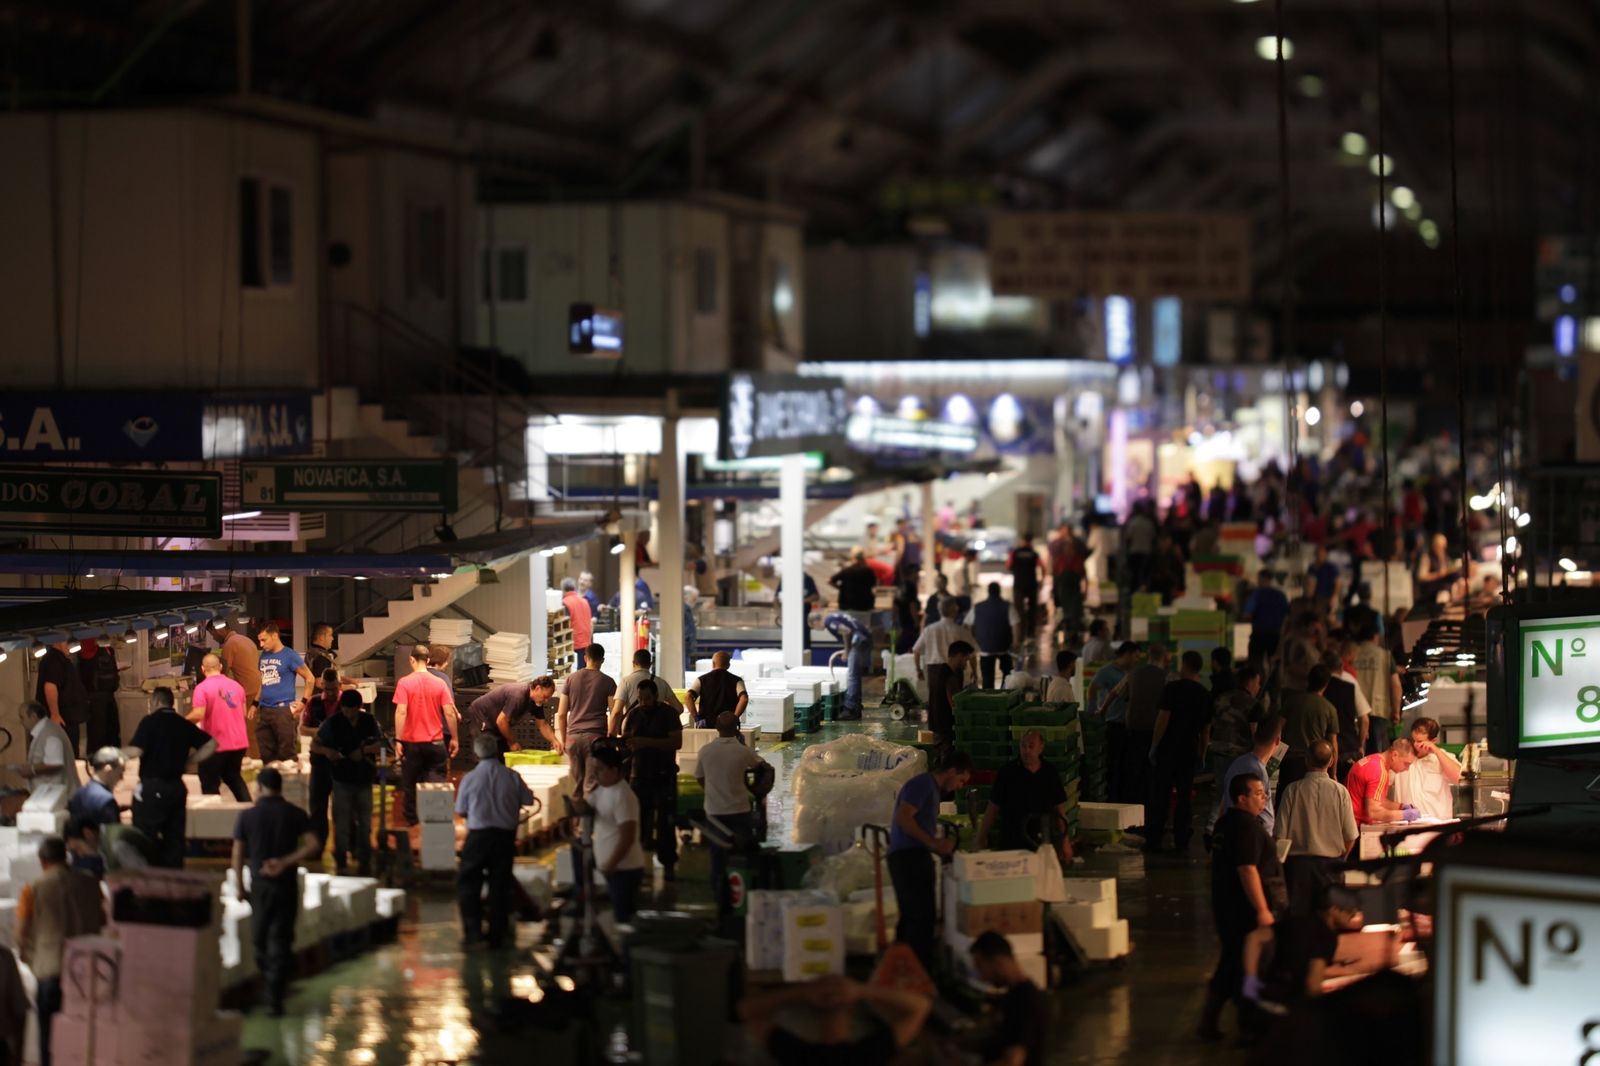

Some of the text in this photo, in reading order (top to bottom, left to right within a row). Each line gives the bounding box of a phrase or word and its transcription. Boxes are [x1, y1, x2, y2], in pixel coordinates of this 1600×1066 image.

[0, 406, 80, 450] .A.
[294, 467, 407, 488] NOVAFICA, S.A.
[260, 486, 274, 500] 81
